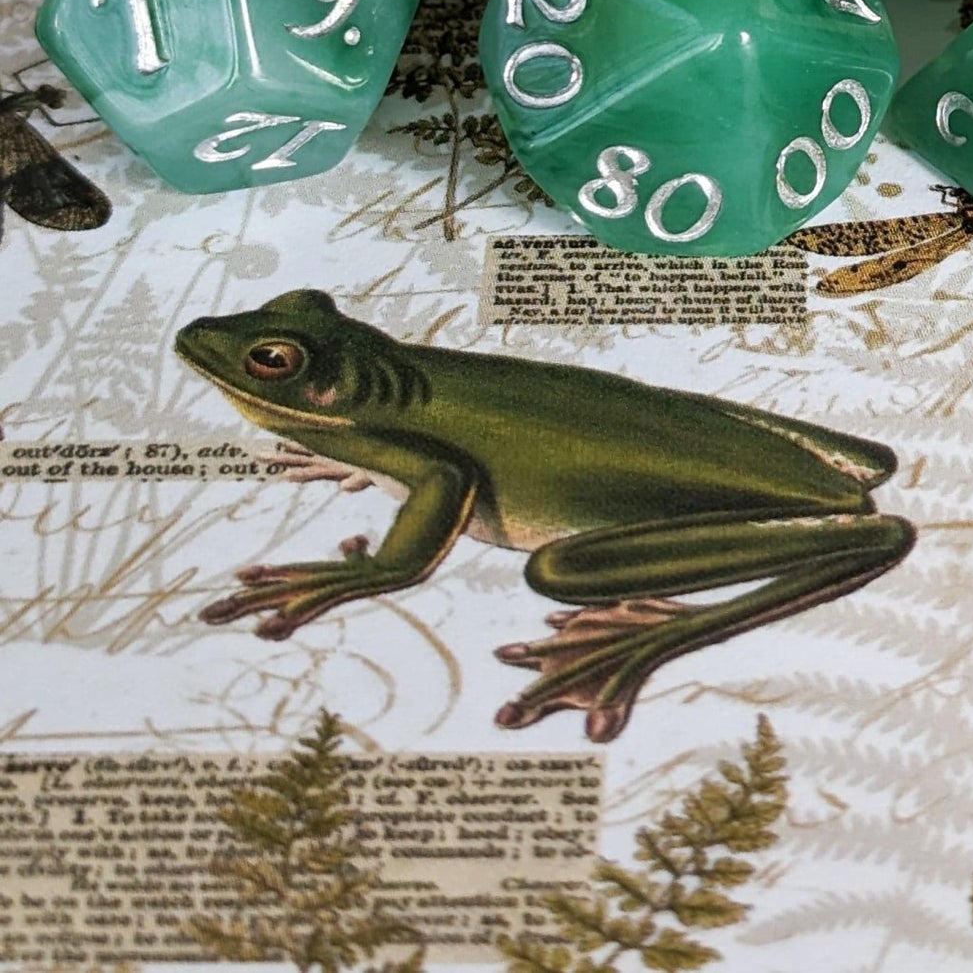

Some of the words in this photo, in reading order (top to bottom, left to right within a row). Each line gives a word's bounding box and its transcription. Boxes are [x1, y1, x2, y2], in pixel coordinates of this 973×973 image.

[192, 111, 347, 170] 12
[775, 79, 872, 210] 00
[578, 146, 724, 244] 80
[2, 462, 41, 476] out
[47, 460, 75, 476] of
[80, 461, 119, 476] the
[218, 461, 259, 475] out
[197, 442, 248, 458] adv.
